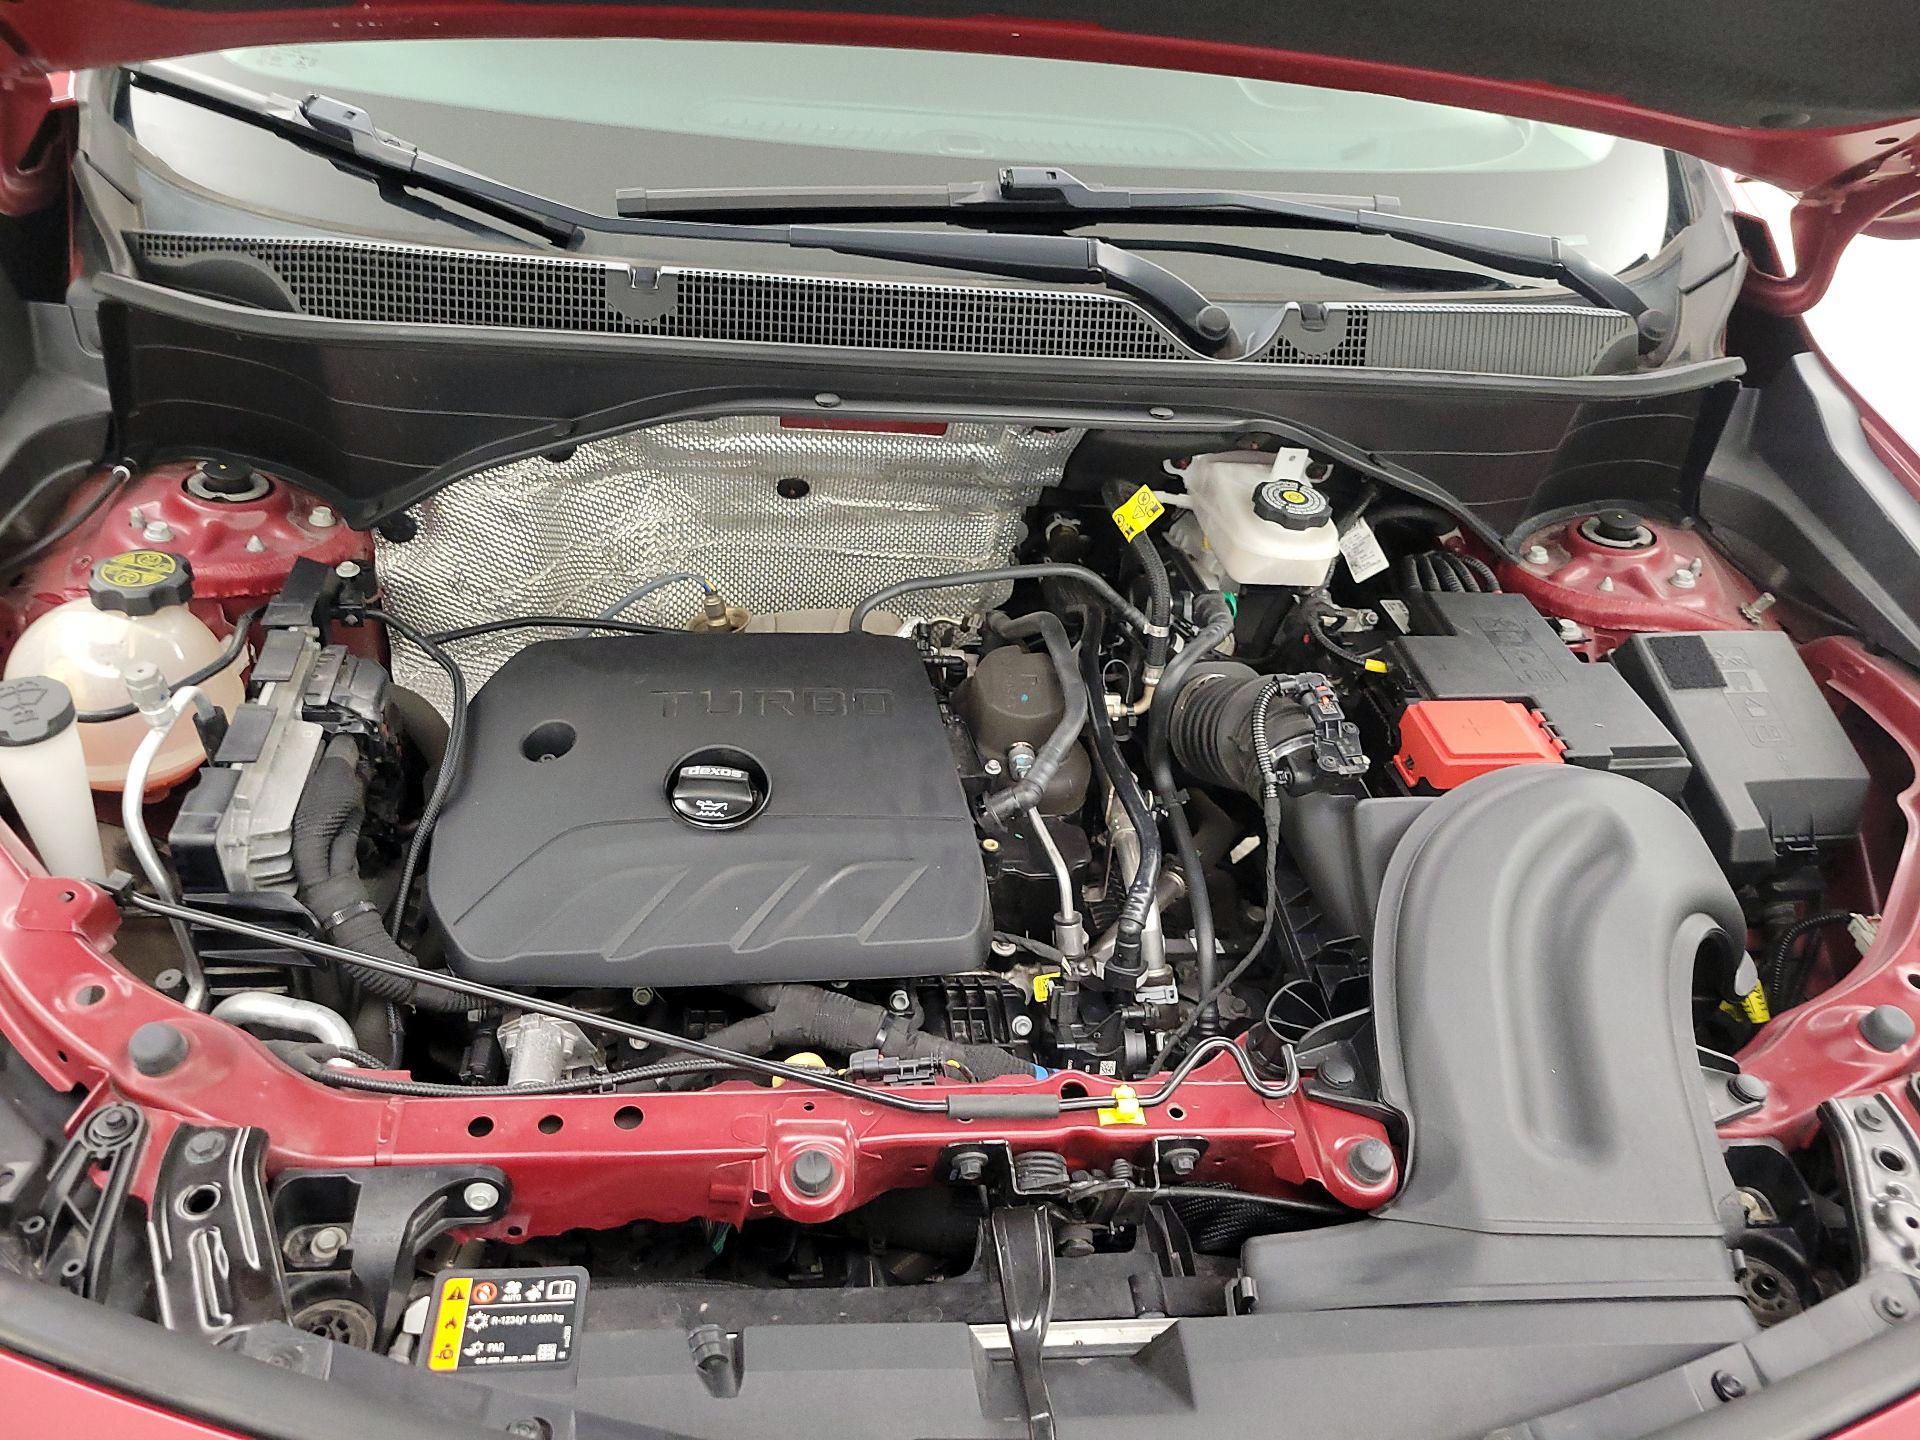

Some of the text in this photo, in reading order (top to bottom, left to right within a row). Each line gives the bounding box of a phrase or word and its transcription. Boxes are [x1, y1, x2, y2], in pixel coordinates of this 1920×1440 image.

[649, 688, 896, 718] TURBO
[687, 765, 744, 778] dexos
[502, 1294, 521, 1302] AUTO
[486, 1342, 505, 1353] PAG
